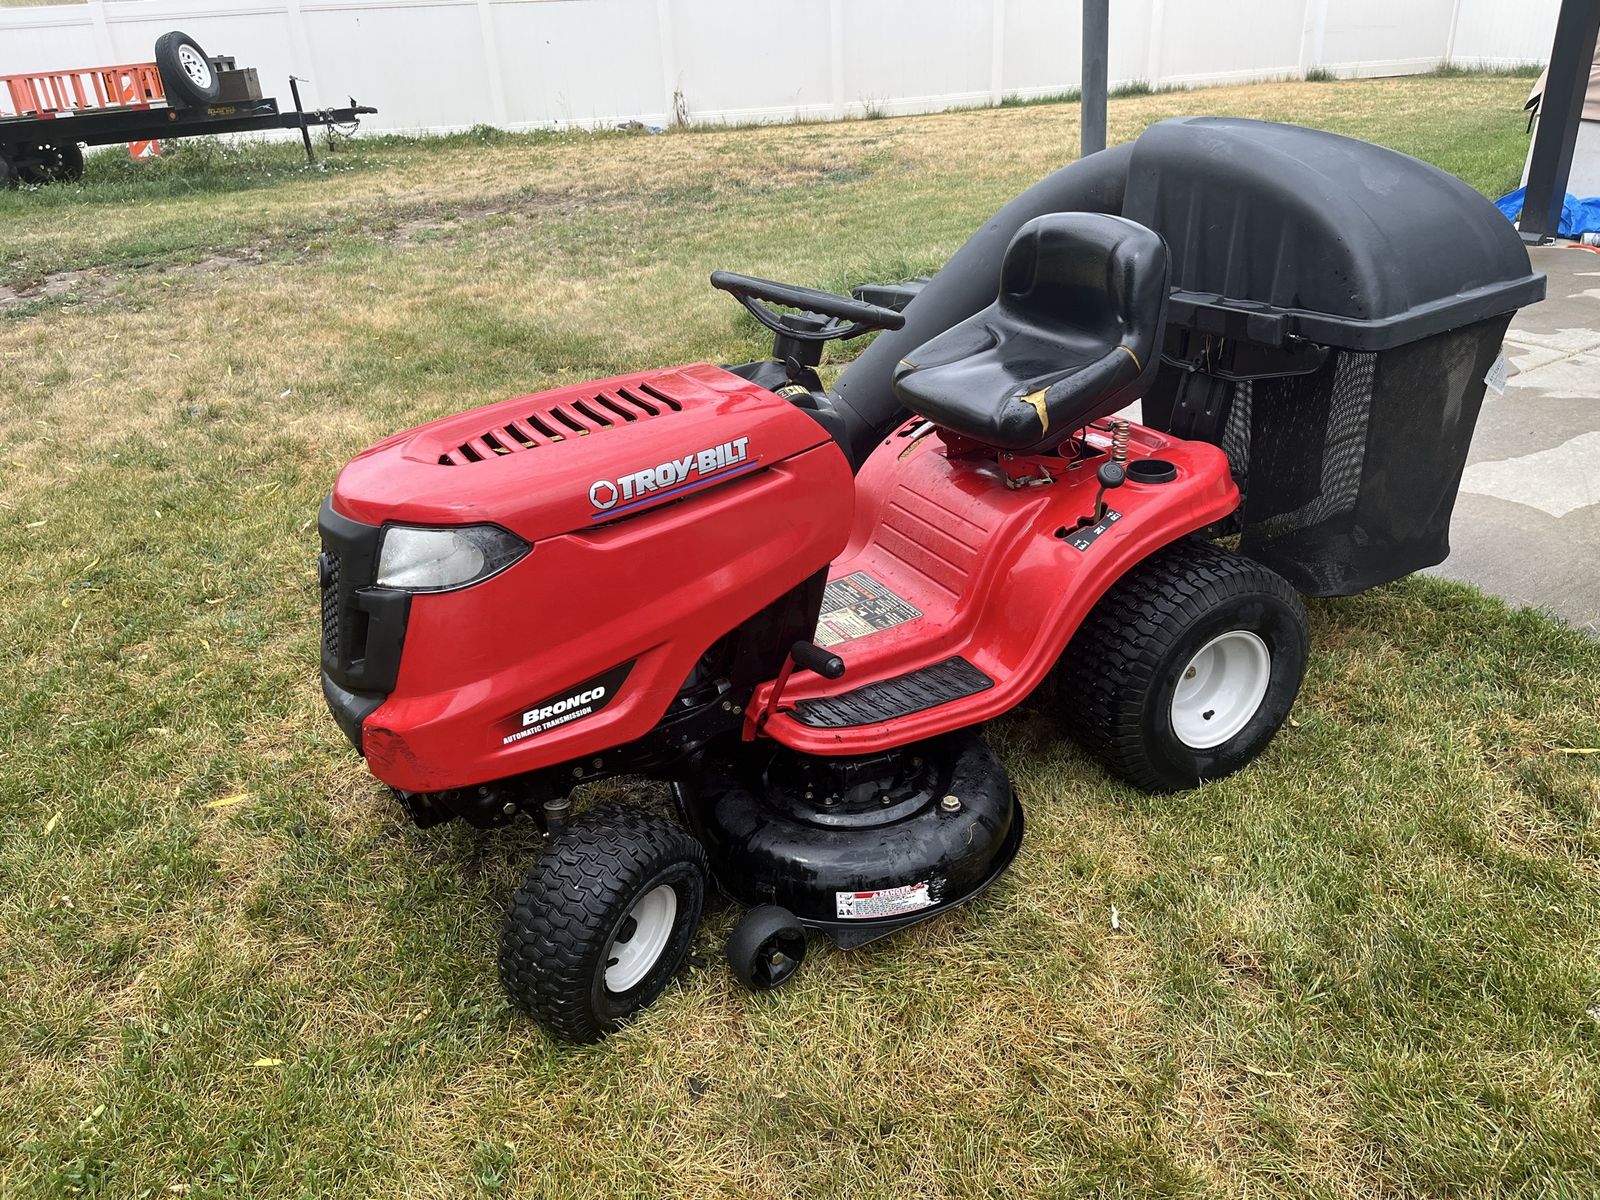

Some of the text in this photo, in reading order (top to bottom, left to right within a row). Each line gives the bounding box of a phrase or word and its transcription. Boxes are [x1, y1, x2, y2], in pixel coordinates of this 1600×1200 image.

[617, 437, 749, 500] TROY-BILT
[503, 706, 592, 744] AUTOMATIC TRANSMISSION
[522, 686, 606, 726] BRONCO
[880, 886, 911, 897] DANGER
